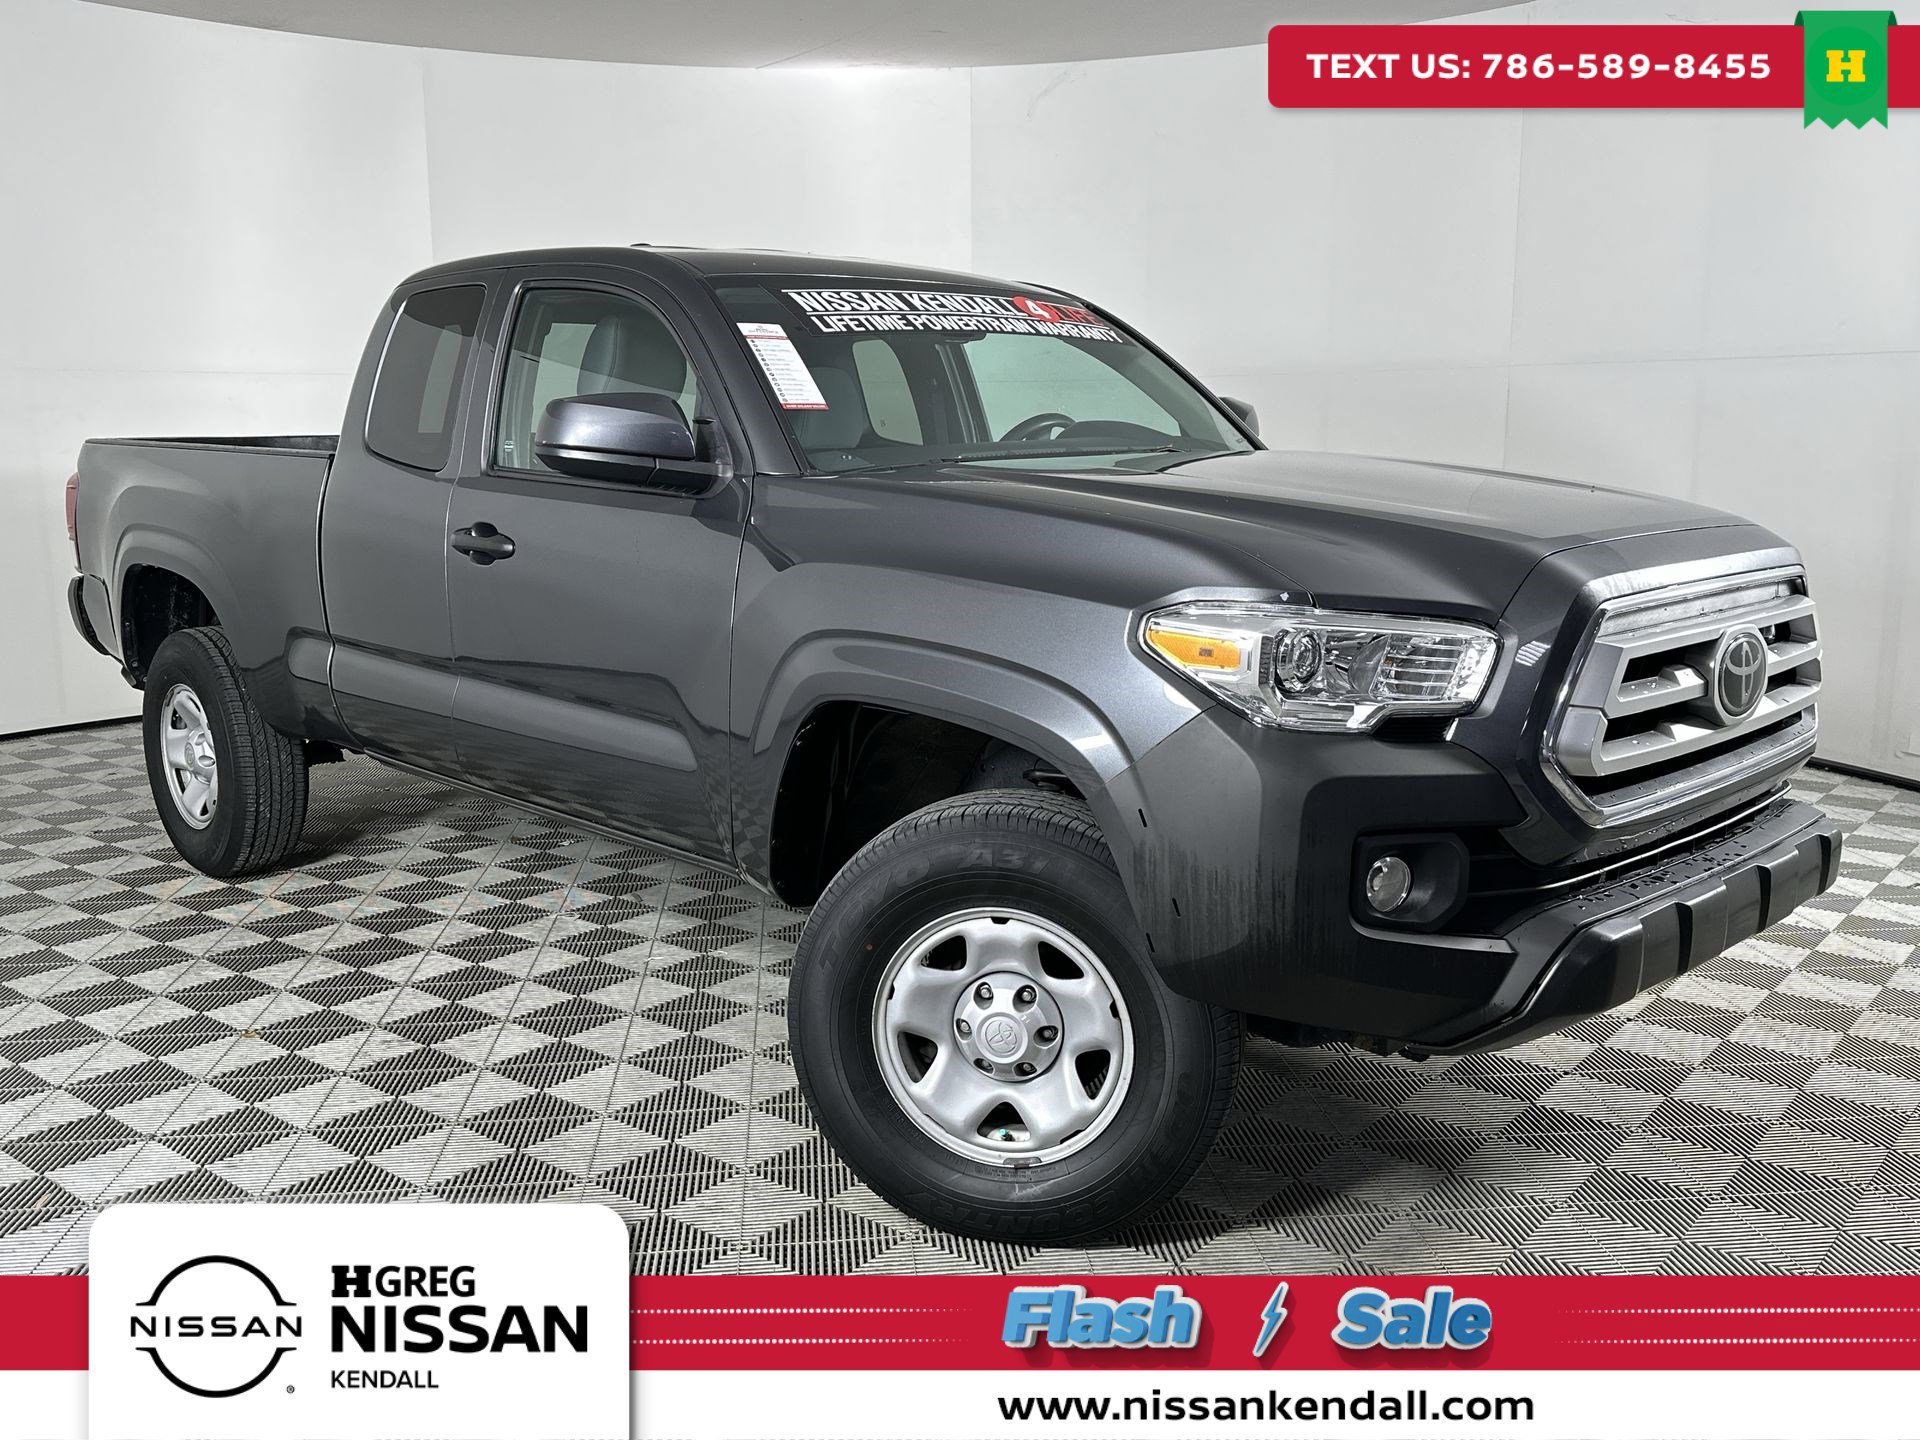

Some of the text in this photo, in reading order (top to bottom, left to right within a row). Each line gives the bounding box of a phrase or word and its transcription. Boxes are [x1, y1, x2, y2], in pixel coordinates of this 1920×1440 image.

[788, 291, 1104, 327] NISSAN KENDALL 4 LIFE
[810, 314, 1124, 343] LIFETIME POWERTRAIN WARRANTY
